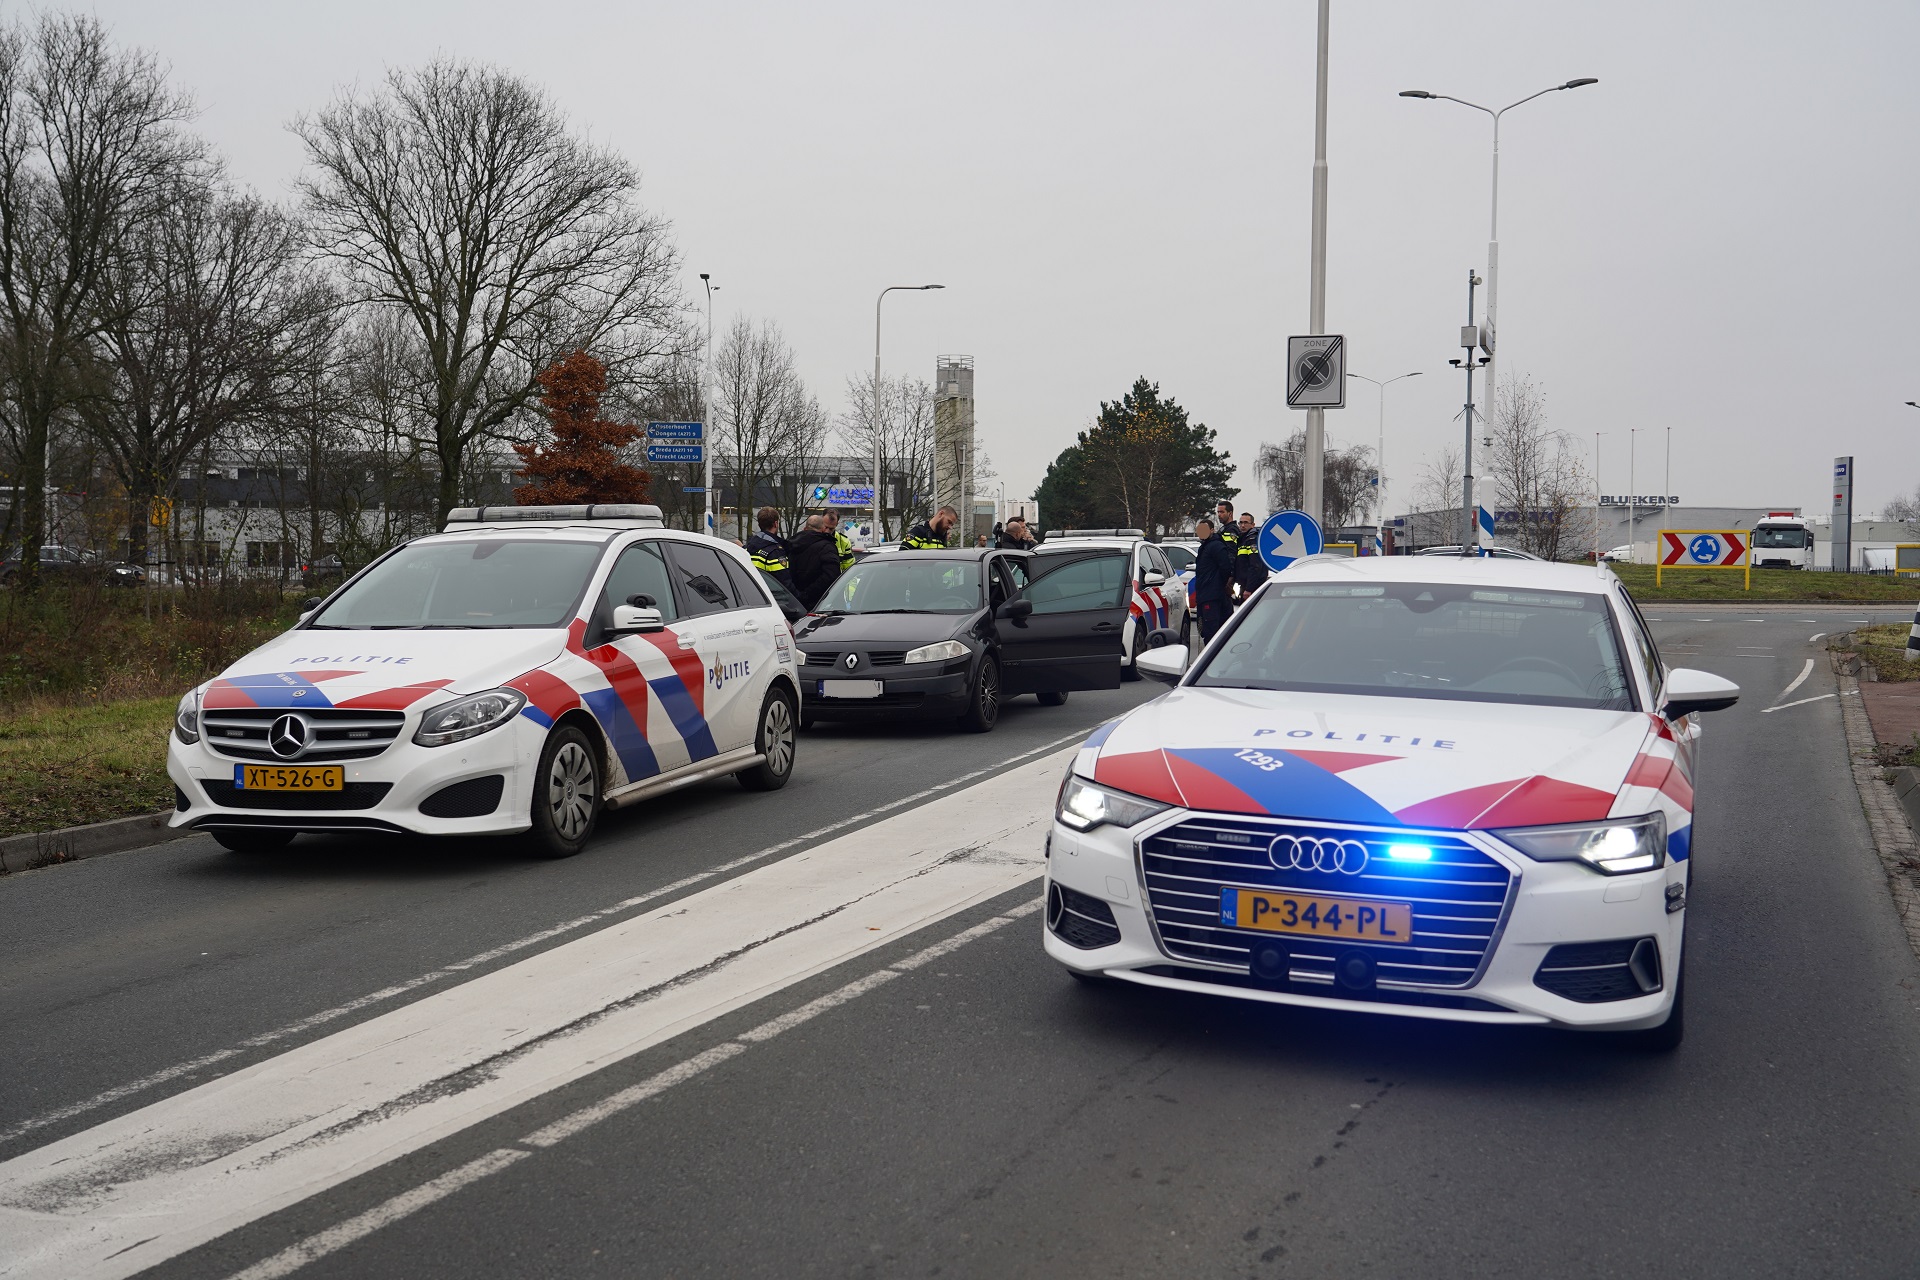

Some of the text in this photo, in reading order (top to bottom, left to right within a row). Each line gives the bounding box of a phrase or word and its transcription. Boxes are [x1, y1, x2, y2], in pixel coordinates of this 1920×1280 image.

[829, 488, 875, 499] MAUSER
[1600, 495, 1680, 504] BLUEKENS
[289, 655, 413, 665] POLITIE
[708, 660, 750, 690] POLITIE
[1252, 729, 1456, 750] POLITIE
[1233, 748, 1284, 772] 1293
[249, 768, 335, 788] XT-526-G
[1222, 896, 1397, 937] NL P-344-PL
